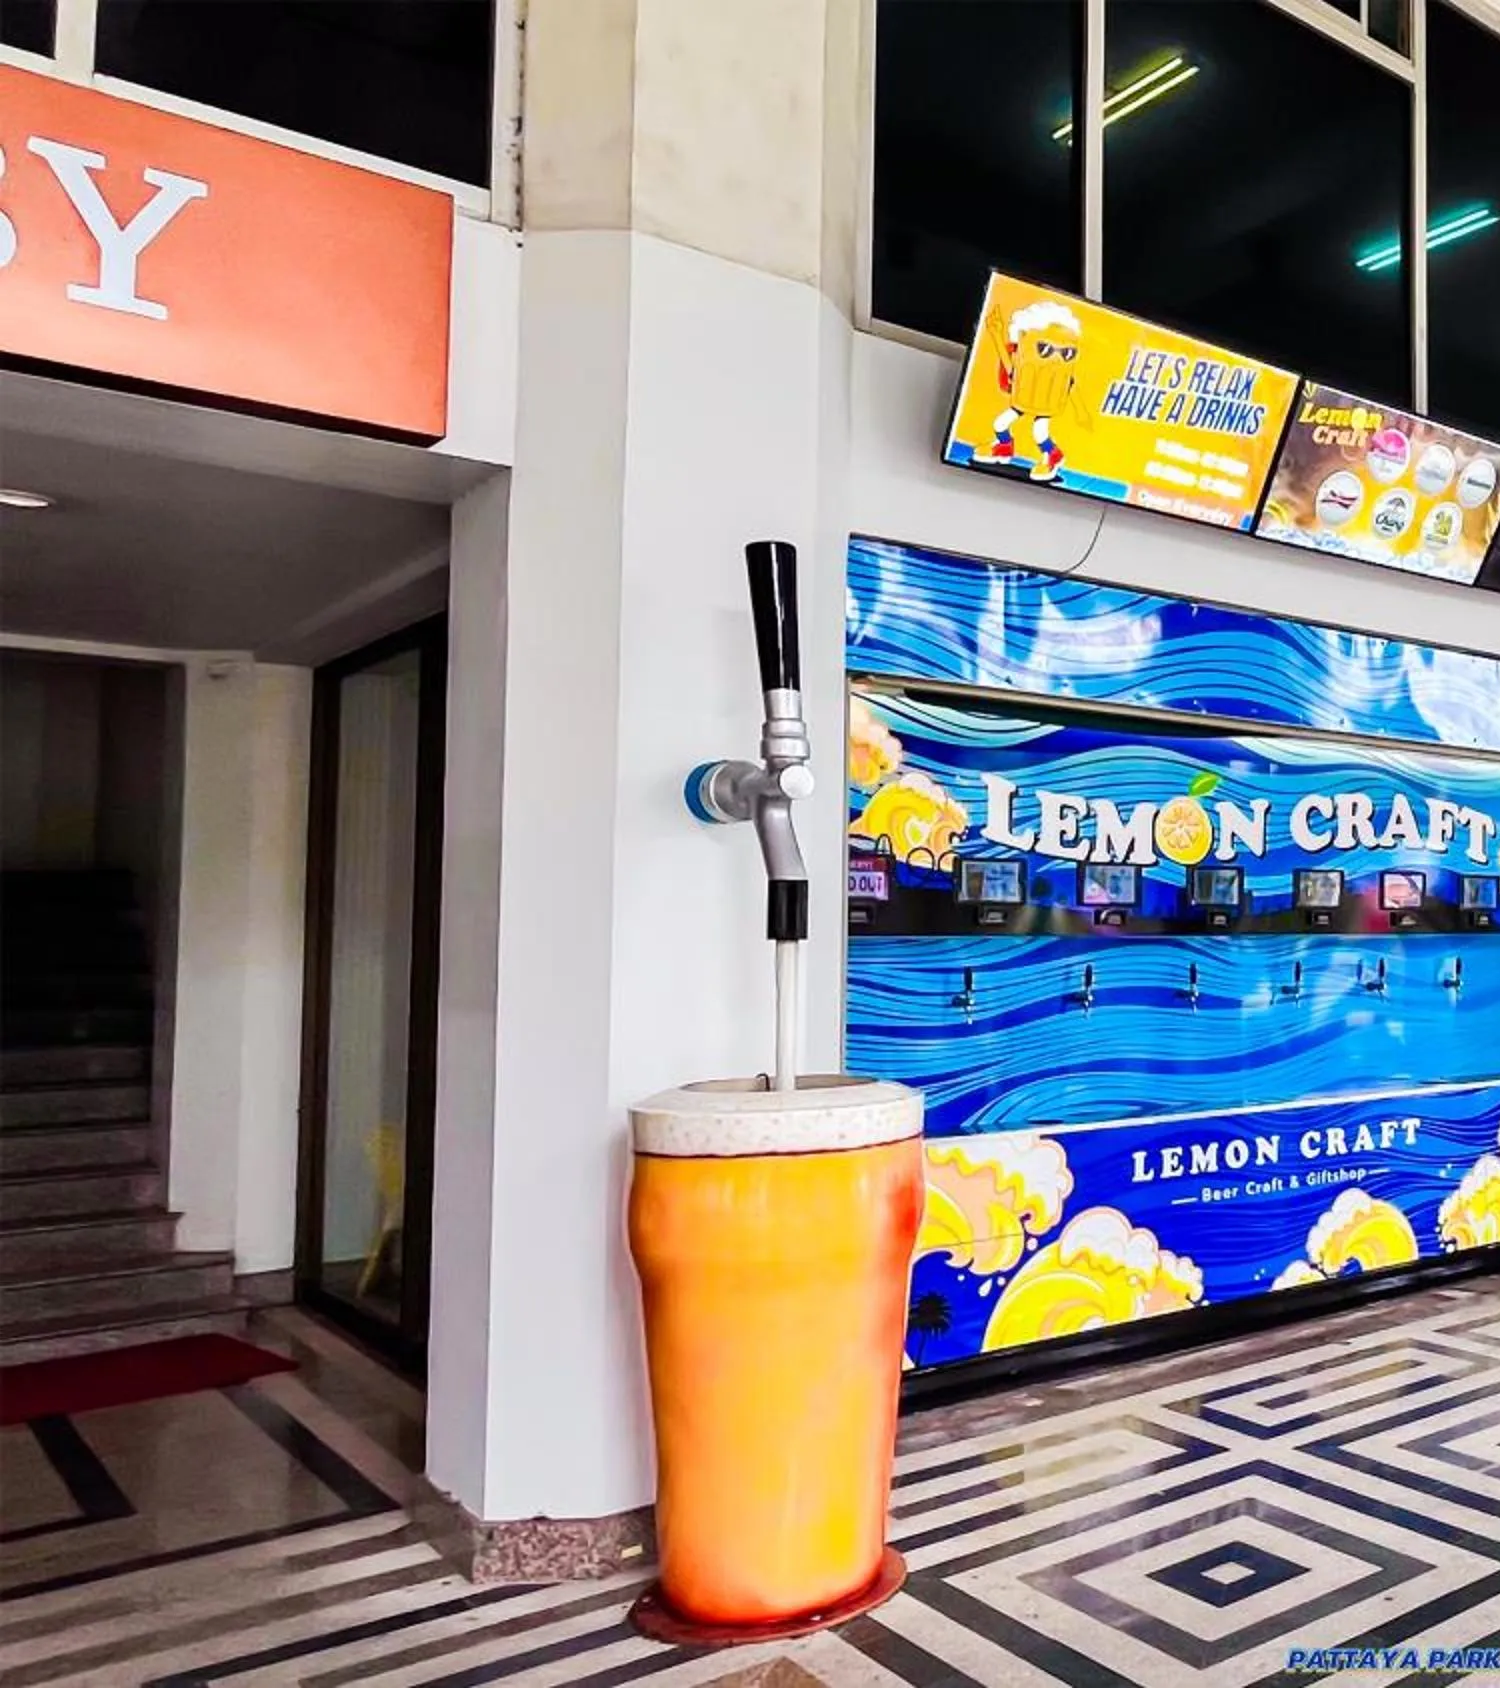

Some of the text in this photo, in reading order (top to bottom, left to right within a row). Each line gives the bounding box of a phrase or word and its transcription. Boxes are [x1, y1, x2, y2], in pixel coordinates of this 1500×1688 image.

[1125, 350, 1257, 401] LET'S RELAX
[1101, 382, 1266, 436] HAVE A DRINKS
[1298, 402, 1382, 429] Lemon
[981, 772, 1497, 866] LEMON CRAFT
[1131, 1117, 1421, 1183] LEMON CRAFT
[1201, 1166, 1368, 1202] Beer Craft & Giftshop
